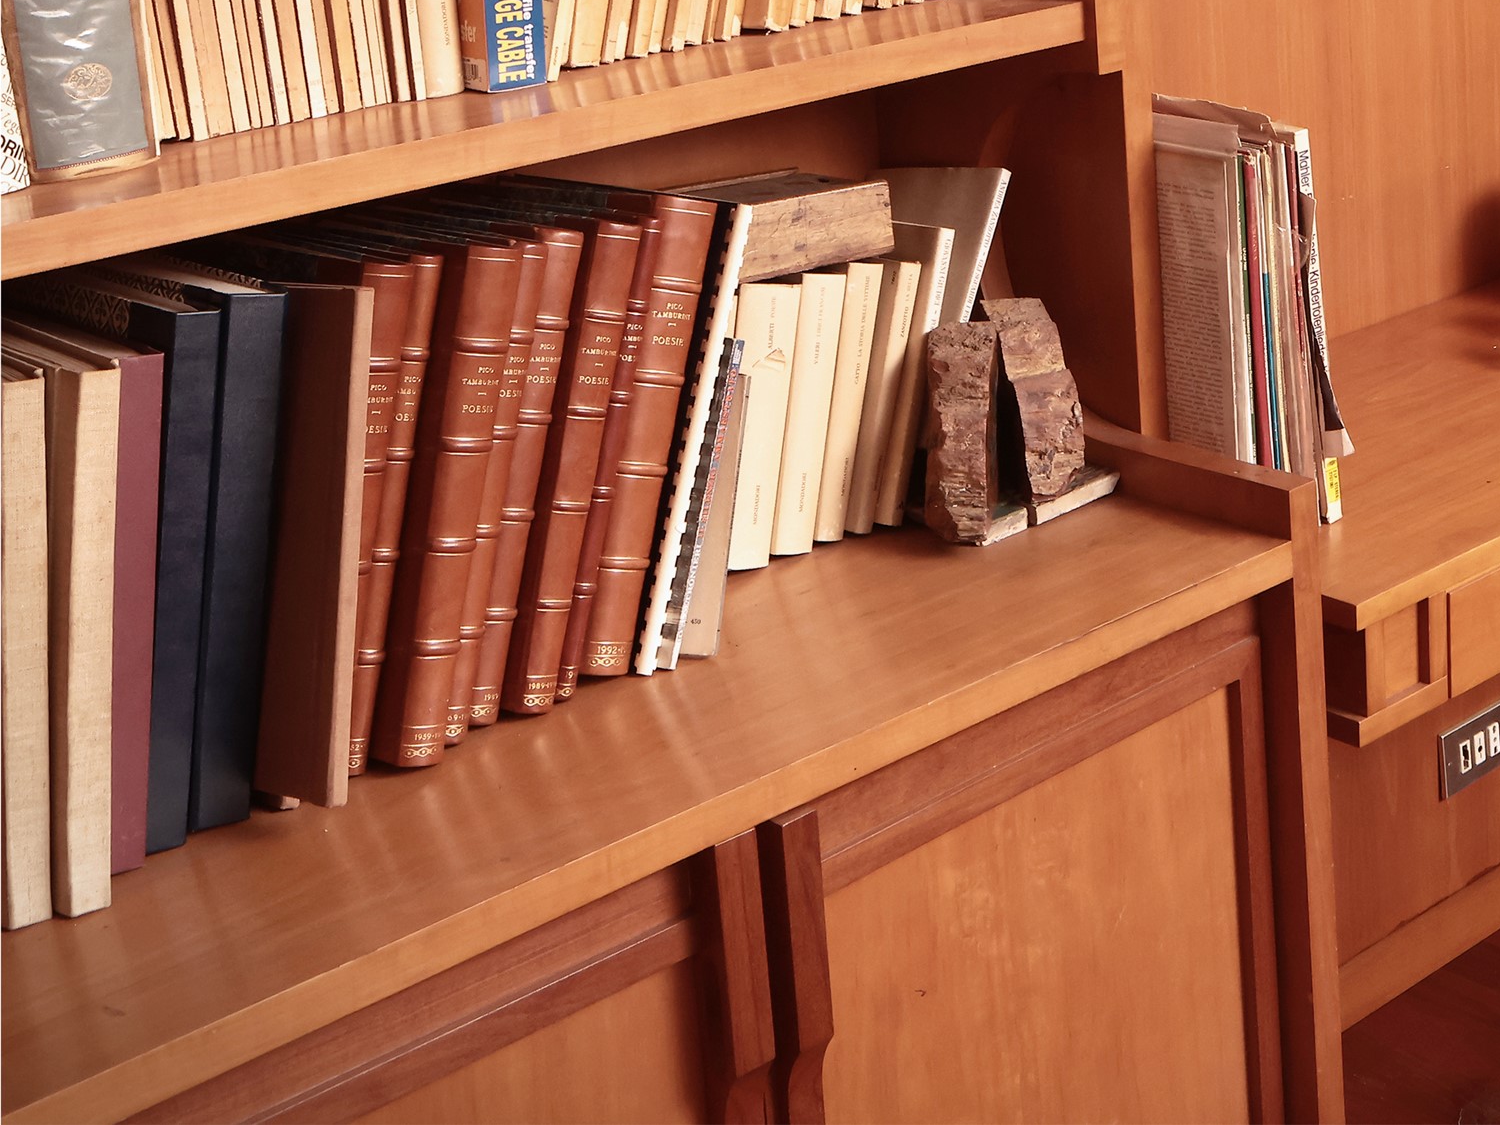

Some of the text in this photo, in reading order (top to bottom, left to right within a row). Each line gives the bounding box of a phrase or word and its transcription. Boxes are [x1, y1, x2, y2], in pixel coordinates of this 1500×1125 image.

[441, 1, 450, 46] MONDADORI
[495, 26, 525, 84] CABLE
[523, 23, 535, 79] transfer
[1299, 150, 1310, 187] Mahler
[993, 179, 1007, 209] ANDREA
[982, 210, 998, 248] ZANZOTTO
[626, 323, 643, 331] PICO
[899, 306, 908, 337] ZANZOTTO
[652, 336, 684, 346] POESIE
[857, 349, 863, 358] LA
[478, 366, 494, 374] PICO
[578, 376, 609, 385] POESIE
[799, 472, 807, 512] MONDADORI
[841, 457, 849, 497] MONDADORI
